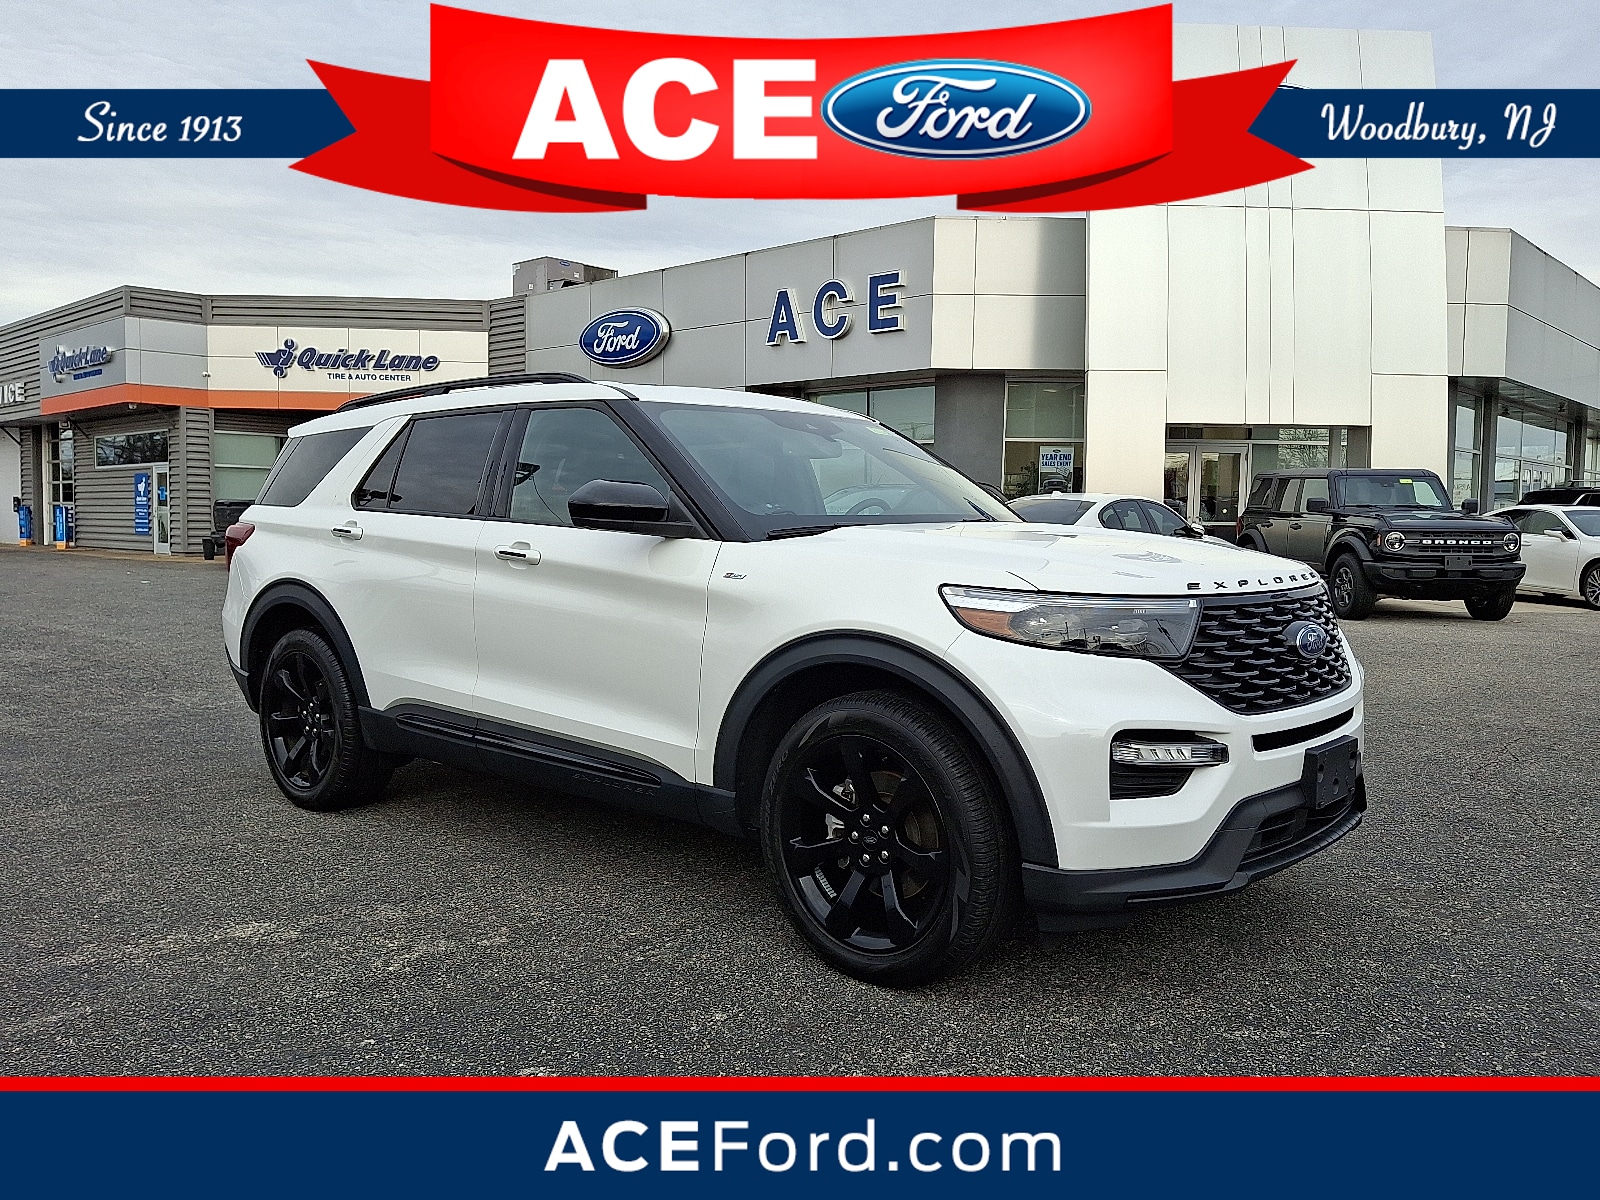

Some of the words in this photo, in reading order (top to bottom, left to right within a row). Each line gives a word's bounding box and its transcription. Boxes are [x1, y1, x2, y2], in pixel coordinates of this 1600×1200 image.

[765, 270, 905, 346] ACE
[593, 320, 640, 353] Ford
[297, 347, 375, 372] Quick
[373, 349, 440, 372] Lane
[327, 372, 347, 381] TIRE
[347, 373, 354, 381] &
[354, 373, 377, 382] AUTO
[378, 374, 412, 383] CENTER
[1041, 453, 1058, 461] YEAR
[1059, 453, 1072, 461] END
